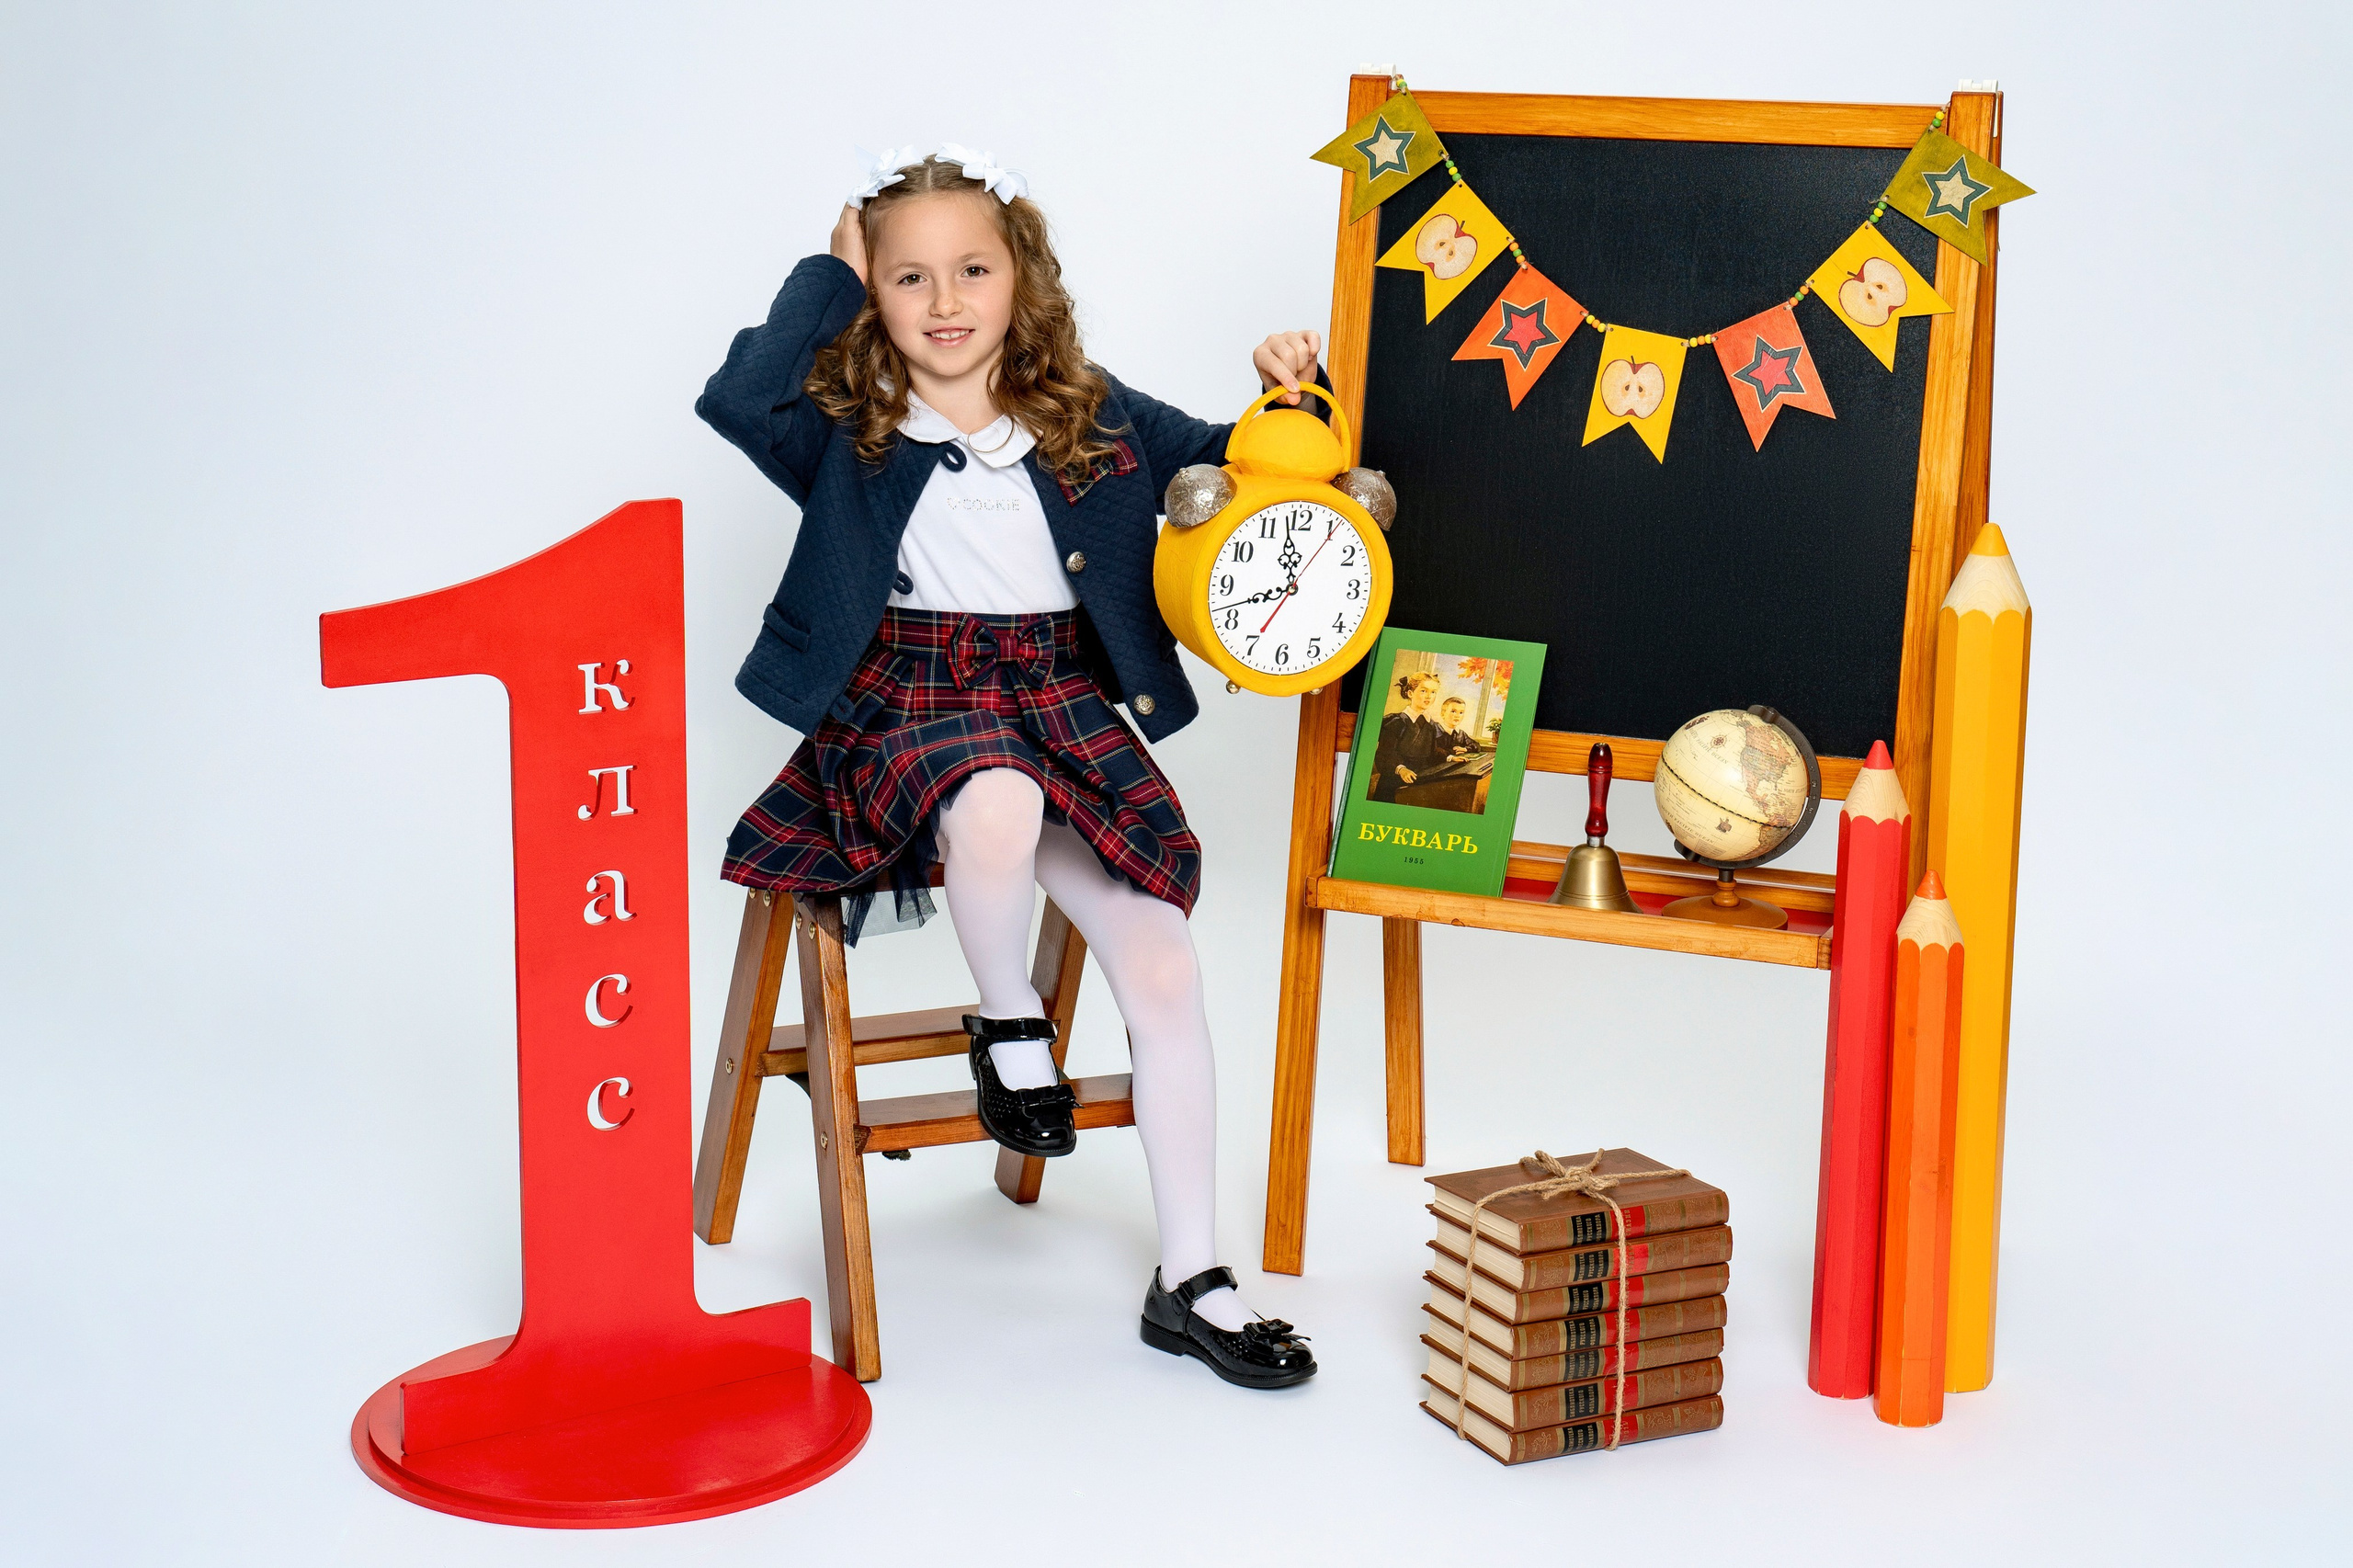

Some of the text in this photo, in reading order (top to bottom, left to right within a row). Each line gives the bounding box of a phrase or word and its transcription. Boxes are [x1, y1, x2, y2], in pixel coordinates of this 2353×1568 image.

[1258, 517, 1277, 539] 11
[1289, 509, 1313, 531] 12
[1324, 519, 1334, 541] 1
[1230, 540, 1254, 562] 10
[1340, 545, 1356, 567] 2
[1220, 574, 1234, 596] 9
[1347, 579, 1360, 599] 3
[1224, 608, 1239, 630] 8
[1332, 612, 1347, 633] 4
[1245, 635, 1260, 655] 7
[1275, 643, 1290, 665] 6
[1307, 636, 1321, 658] 5
[1358, 823, 1478, 854] БУКВАРЬ
[1404, 857, 1424, 865] 1955
[577, 658, 636, 1132] класс
